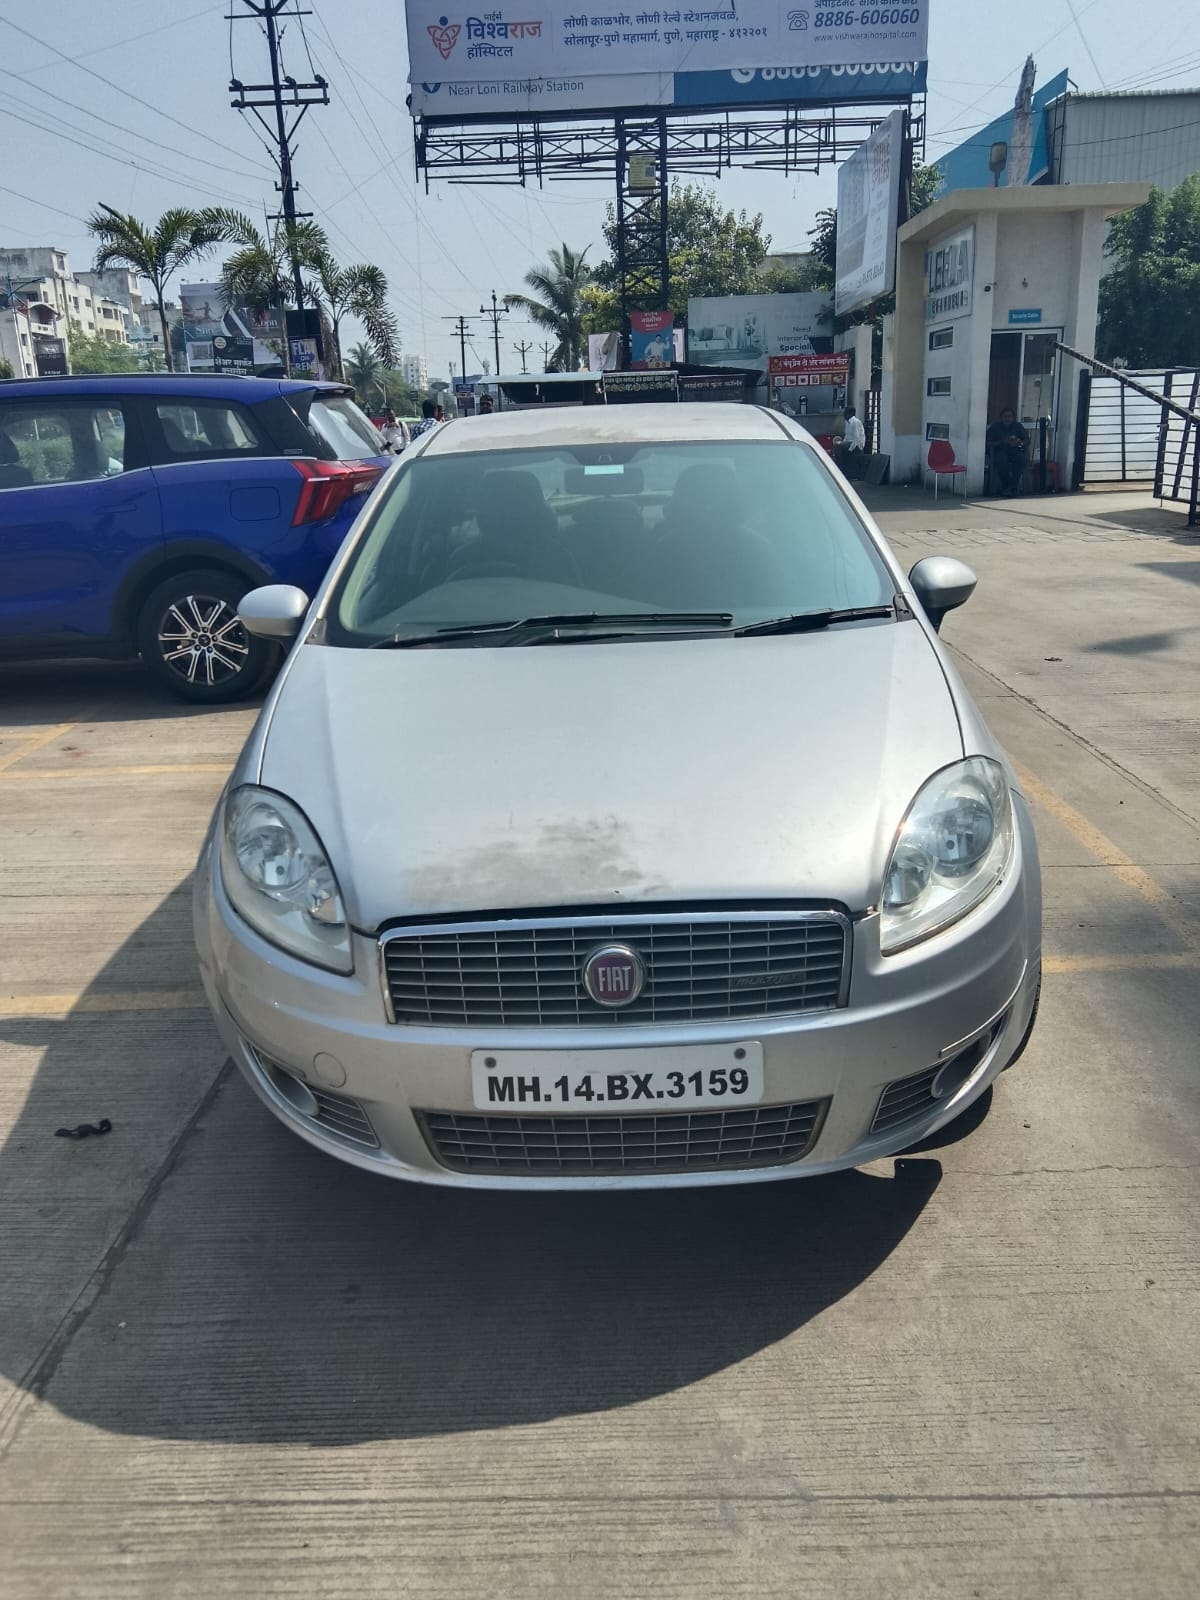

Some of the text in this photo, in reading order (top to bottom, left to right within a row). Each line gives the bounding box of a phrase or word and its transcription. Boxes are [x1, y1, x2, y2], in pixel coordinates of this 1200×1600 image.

[563, 15, 588, 28] लोणी
[590, 13, 633, 26] काळभोर,
[636, 11, 661, 24] लोणी
[814, 9, 920, 27] 8886-606060
[466, 17, 543, 39] विश्वराज
[564, 32, 620, 48] सोलापूर-पुणे
[623, 29, 661, 44] महामार्ग,
[664, 29, 683, 44] पुणे,
[686, 29, 720, 42] महाराष्ट्र
[729, 27, 768, 38] ४१२२०१
[467, 42, 513, 59] हॉस्पिटल
[448, 80, 584, 96] Near Loni Railway Station
[598, 965, 632, 992] FIAT
[487, 1069, 749, 1102] MH.14.BX.3159
